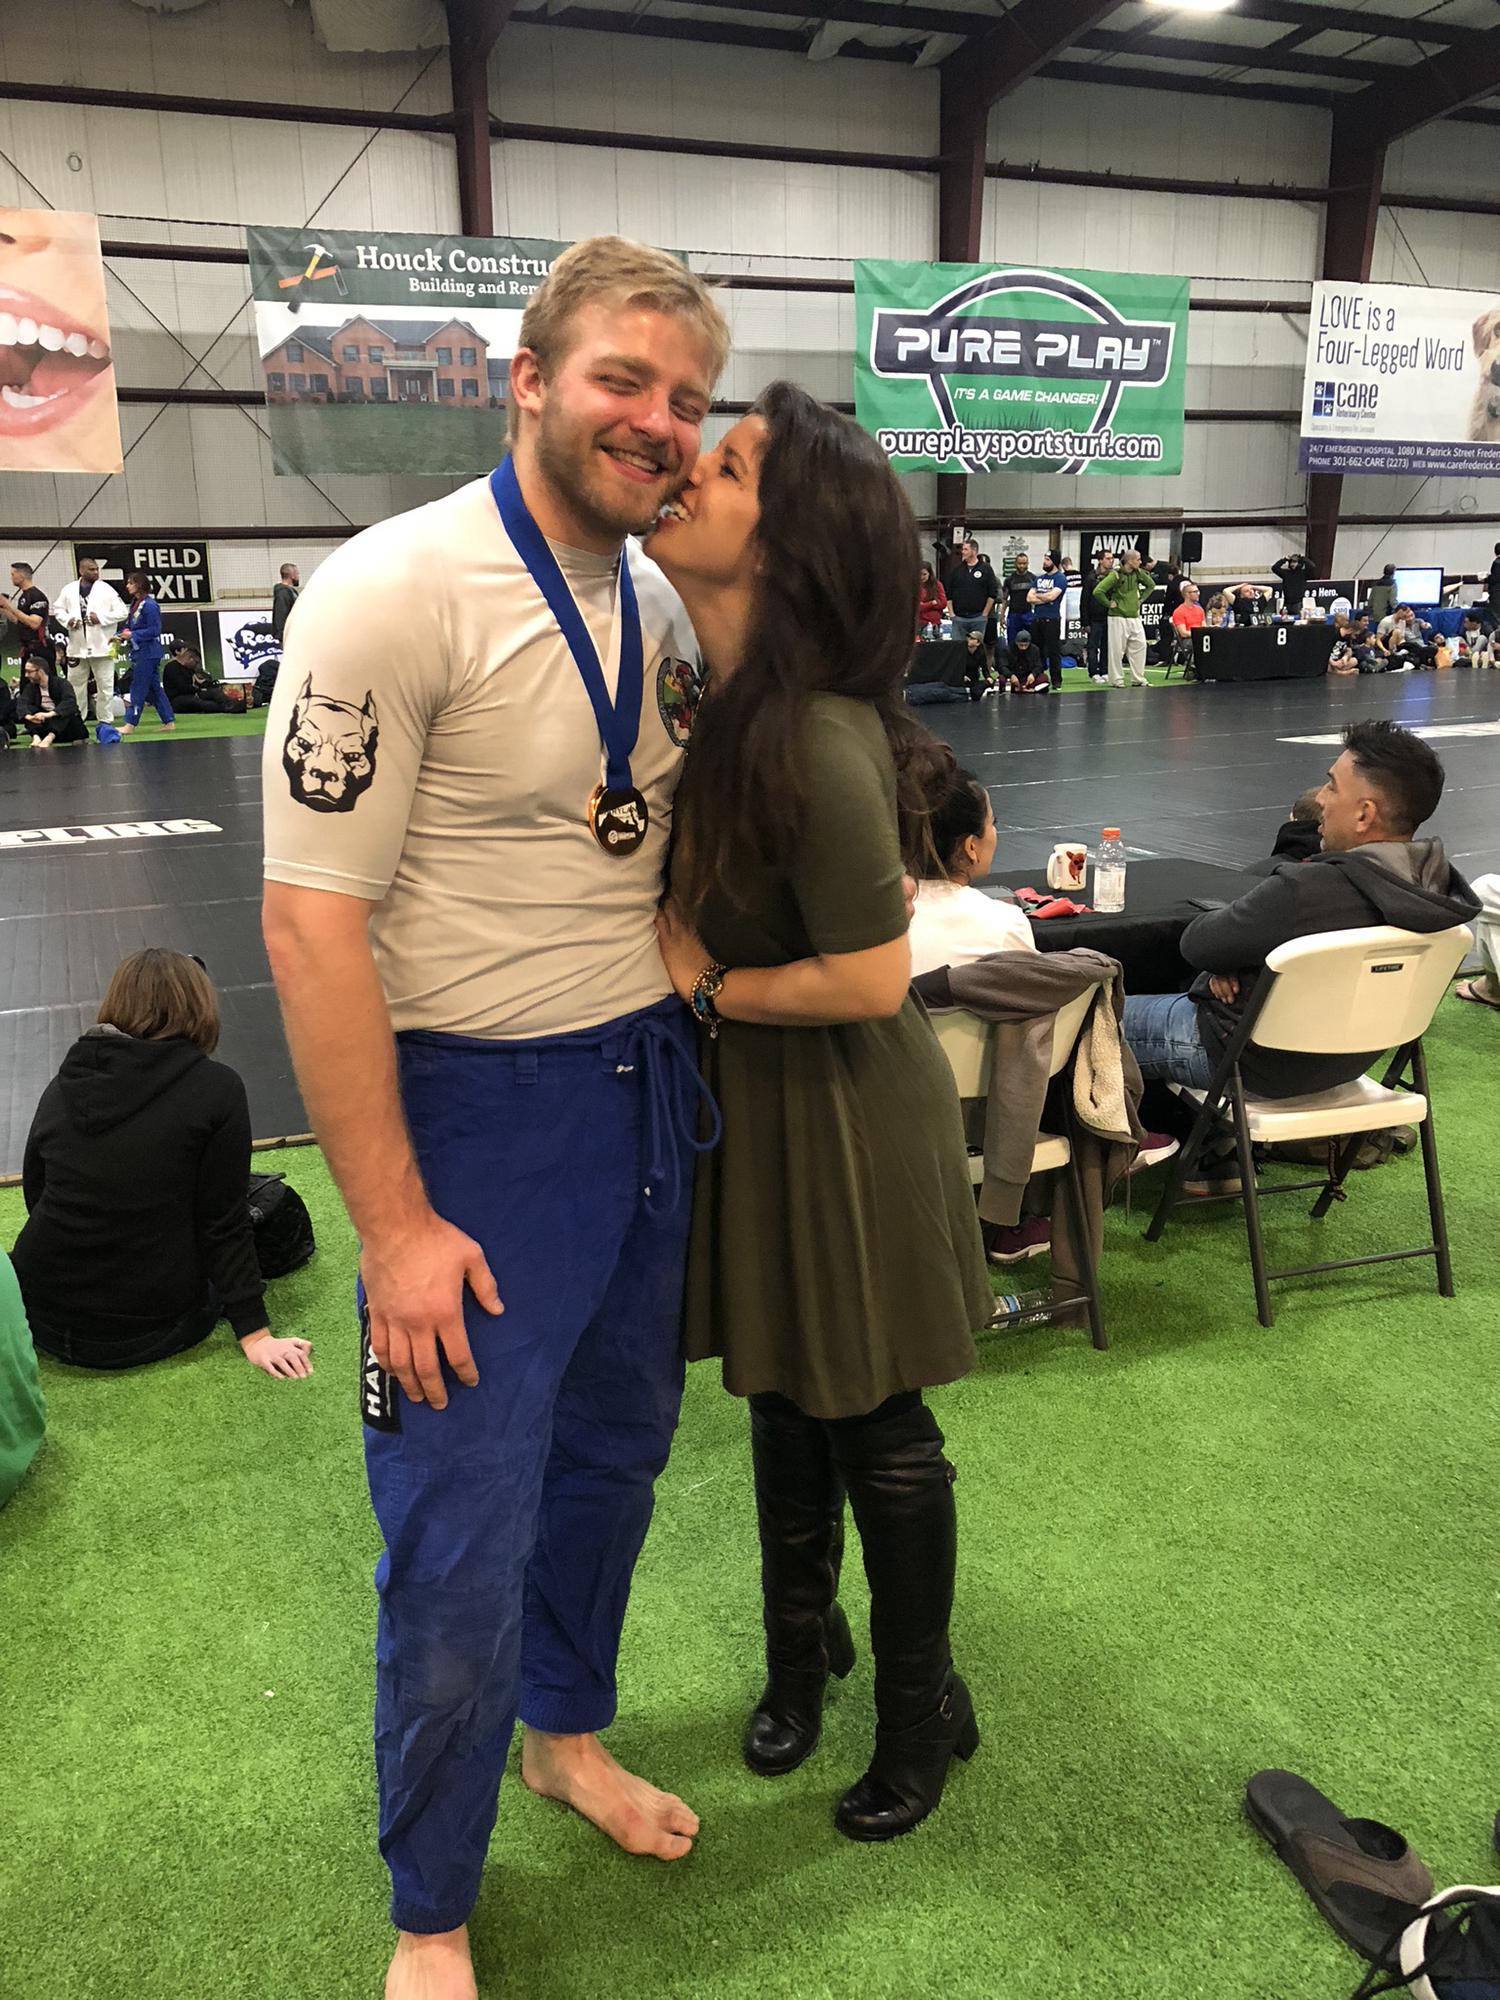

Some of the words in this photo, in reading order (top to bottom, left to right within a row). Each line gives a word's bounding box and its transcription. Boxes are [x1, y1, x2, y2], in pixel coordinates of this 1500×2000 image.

[355, 245, 443, 272] Houck
[408, 278, 475, 297] Building
[478, 281, 506, 295] and
[1319, 294, 1363, 330] LOVE
[1367, 300, 1381, 331] is
[1386, 308, 1395, 332] a
[893, 327, 1021, 364] PURE
[1316, 331, 1420, 375] Four-Legged
[1424, 337, 1465, 371] Word
[953, 388, 976, 400] IT'S
[977, 389, 990, 399] A
[993, 389, 1033, 402] GAME
[1035, 391, 1100, 405] CHANGER!
[879, 426, 1161, 460] pureplaysportsturf.com
[1308, 444, 1323, 454] 24/7
[1324, 444, 1363, 455] EMERGENCY
[1363, 446, 1394, 456] HOSPITAL
[1426, 446, 1452, 457] Patrick
[1453, 447, 1475, 458] Street
[1308, 457, 1331, 465] PHONE
[1332, 456, 1385, 467] 301-662-CARE
[1386, 457, 1410, 469] (2273)
[1091, 534, 1139, 555] AWAY
[133, 548, 201, 568] FIELD
[148, 575, 204, 600] XIT
[1318, 587, 1339, 598] Hero.
[1141, 603, 1165, 615] EXIT
[1140, 614, 1163, 626] HER
[1203, 635, 1211, 653] 8
[1277, 628, 1287, 646] 8
